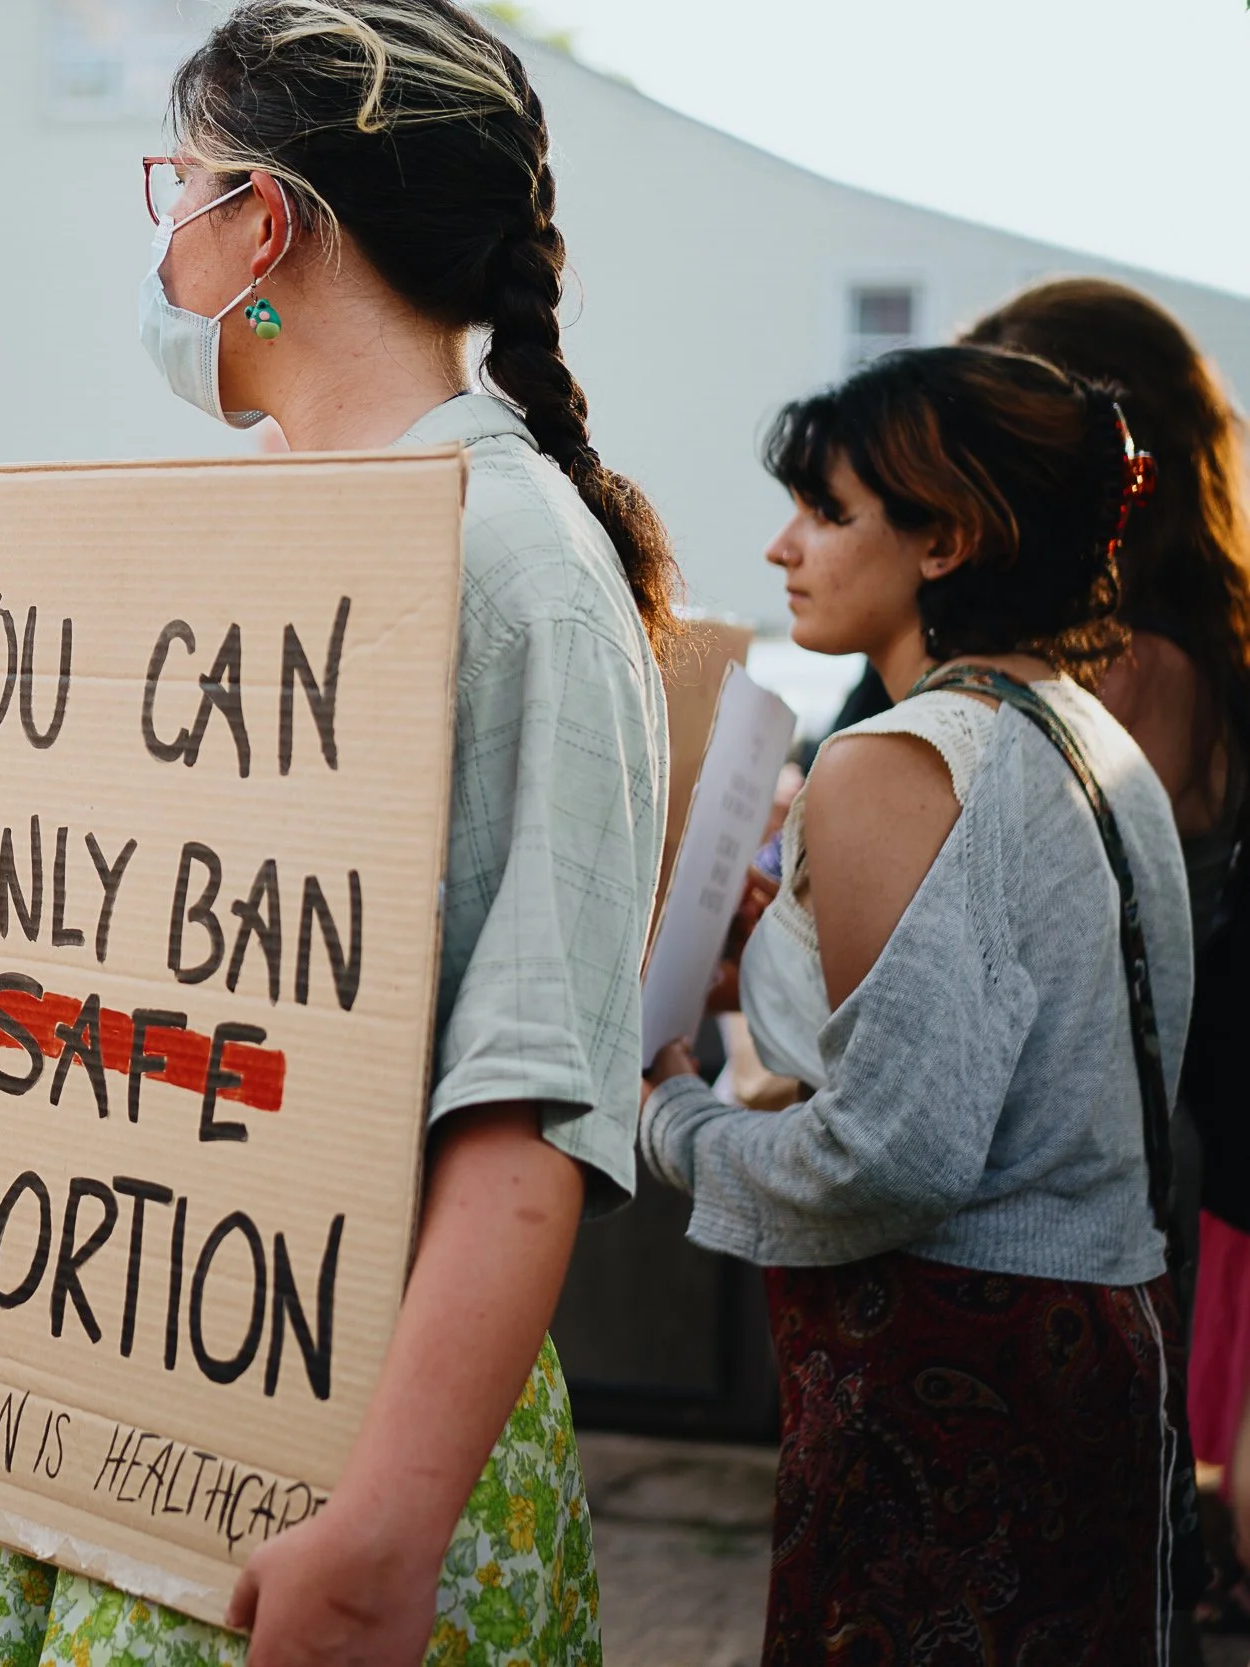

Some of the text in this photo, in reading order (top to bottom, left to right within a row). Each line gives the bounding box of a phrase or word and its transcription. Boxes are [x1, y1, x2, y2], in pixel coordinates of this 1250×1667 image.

[141, 595, 351, 779] CAN
[167, 842, 363, 1012] BAN
[33, 1410, 71, 1479] IS
